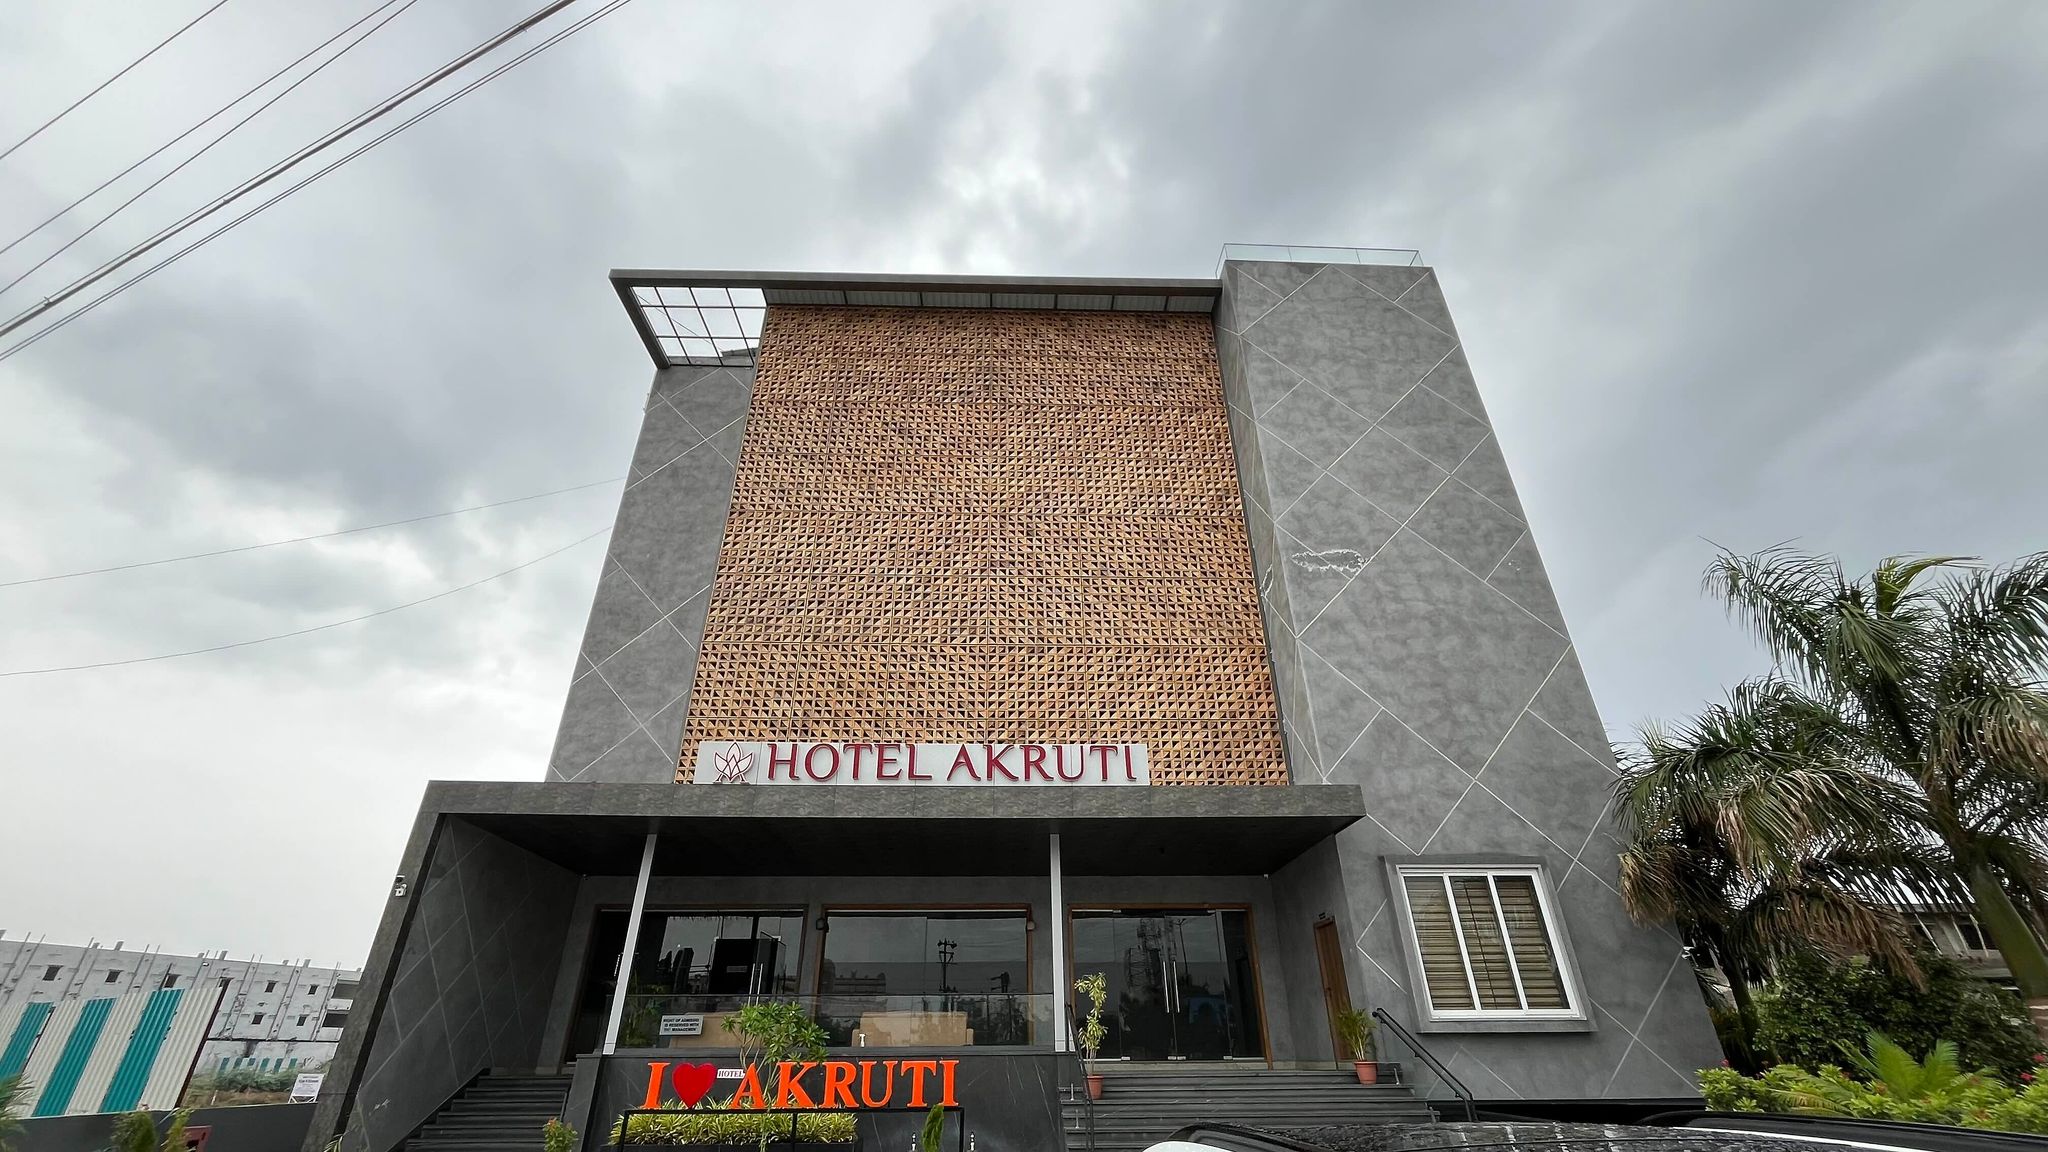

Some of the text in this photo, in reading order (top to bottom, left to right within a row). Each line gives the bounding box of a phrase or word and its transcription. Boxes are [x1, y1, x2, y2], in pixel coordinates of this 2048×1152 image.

[767, 743, 1138, 782] HOTEL AKRUTI
[640, 1060, 960, 1109] I AKRUTI
[718, 1070, 744, 1078] HOTEL
